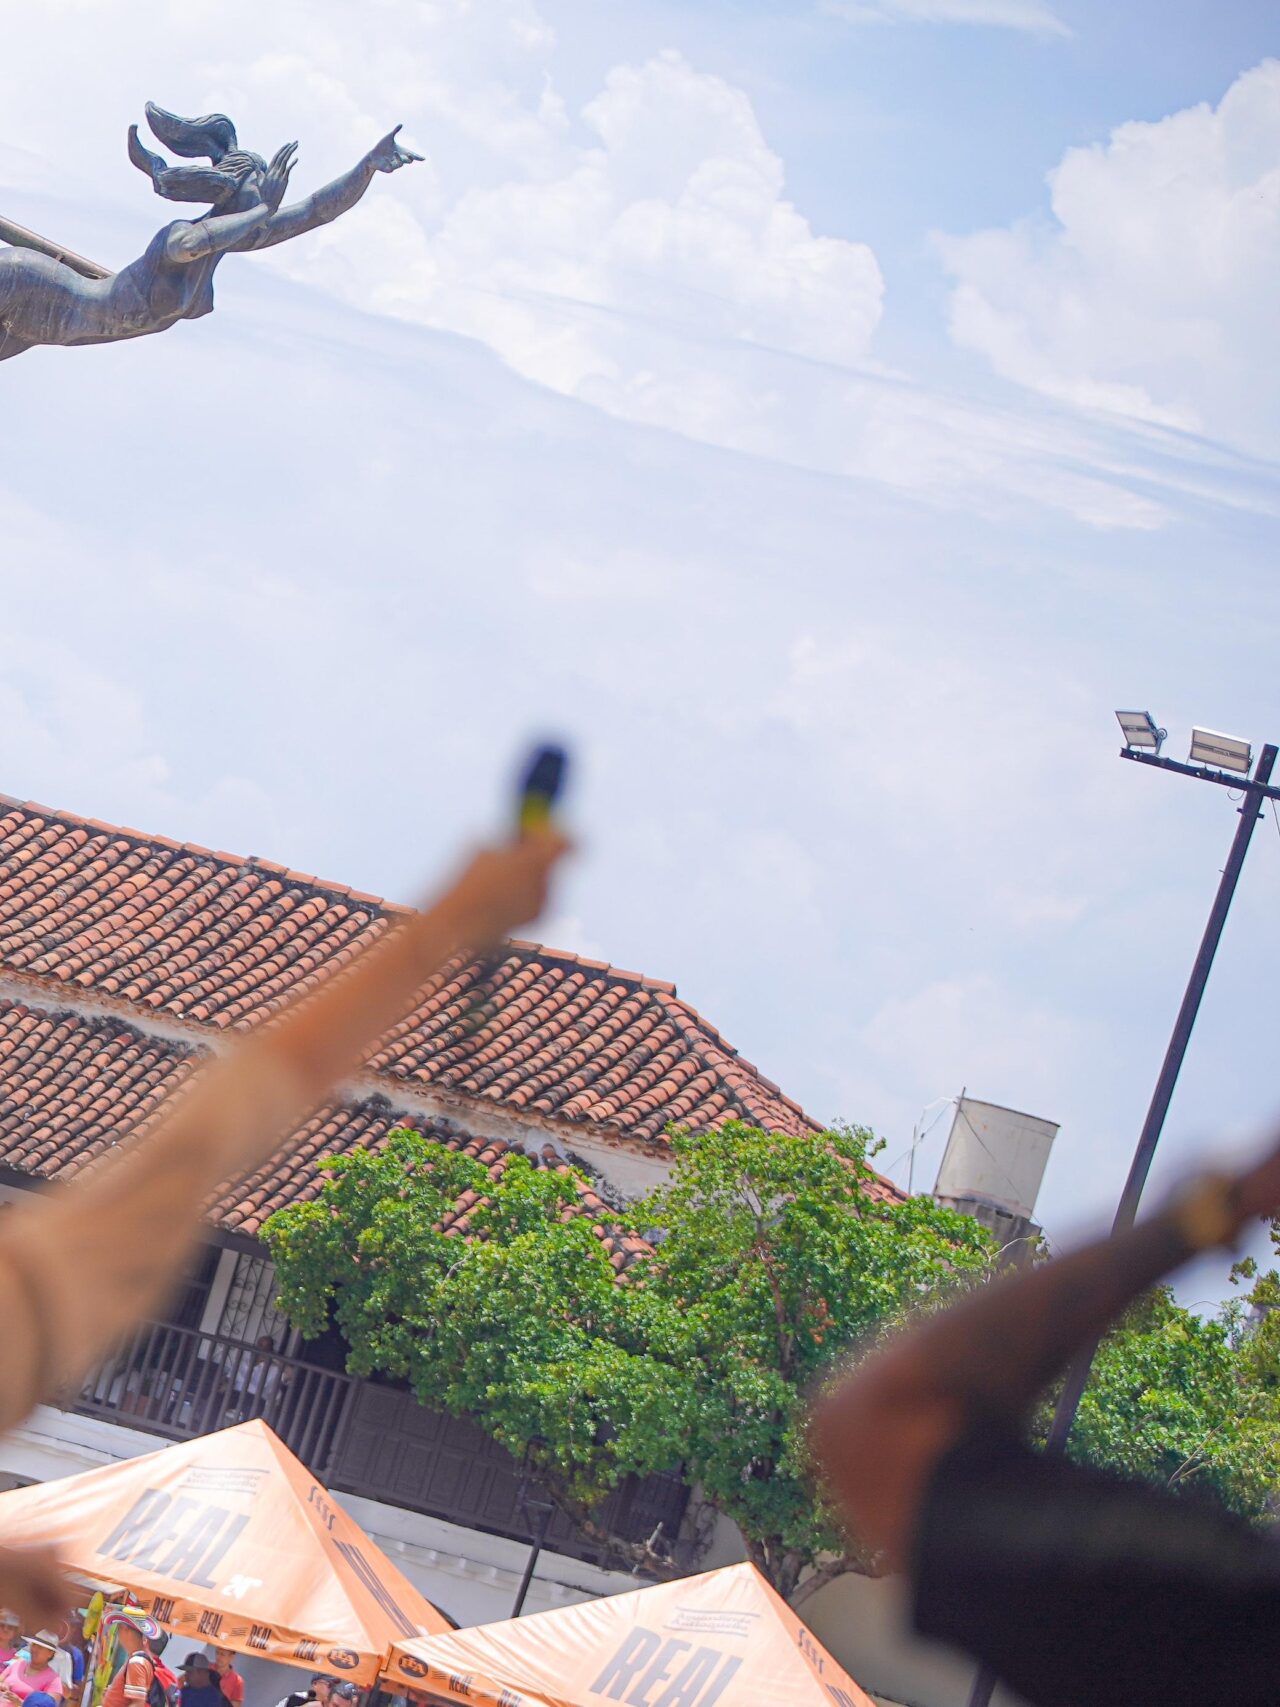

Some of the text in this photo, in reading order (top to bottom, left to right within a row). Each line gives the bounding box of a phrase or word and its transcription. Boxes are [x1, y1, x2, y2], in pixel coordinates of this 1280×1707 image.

[96, 1488, 251, 1590] REAL
[197, 1610, 224, 1638] REAL
[245, 1623, 272, 1650] REAL
